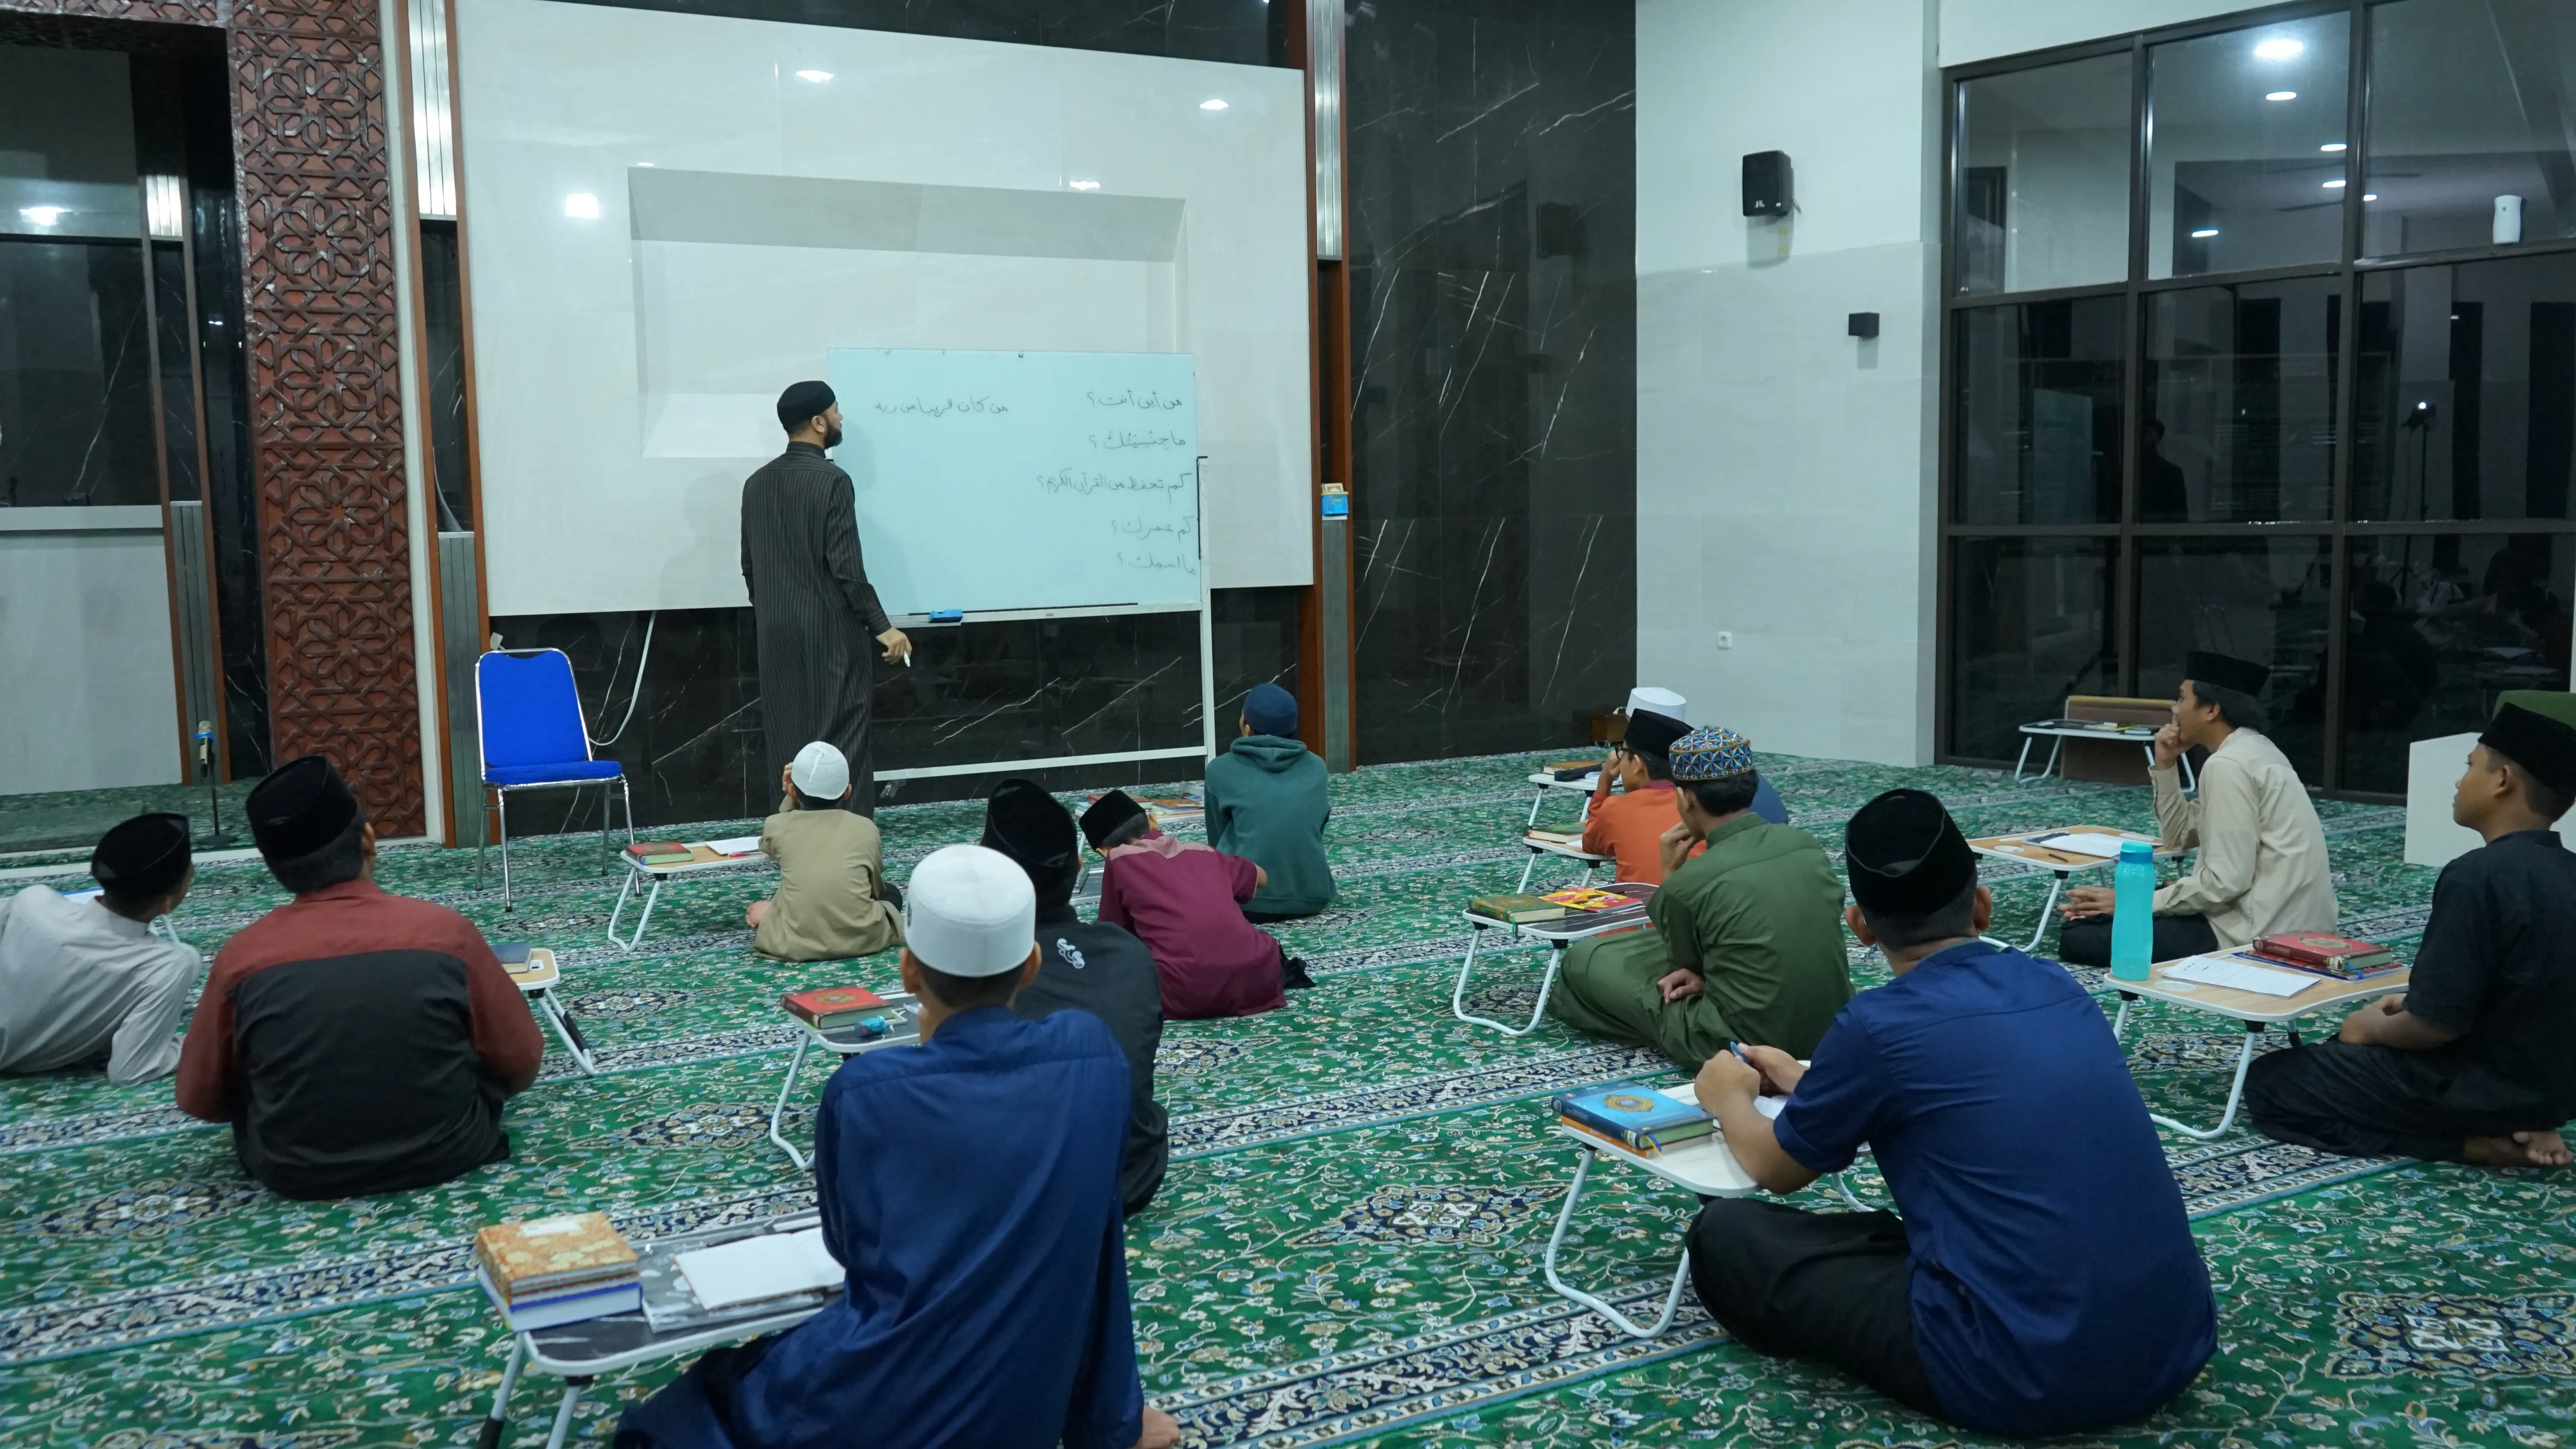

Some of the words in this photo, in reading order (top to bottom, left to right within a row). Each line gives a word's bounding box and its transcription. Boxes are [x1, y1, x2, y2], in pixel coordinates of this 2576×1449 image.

[900, 403, 917, 413] من
[917, 397, 953, 417] قريبا
[958, 395, 989, 412] كان
[990, 403, 1008, 413] من
[1138, 391, 1160, 409] أين
[1163, 397, 1182, 409] من
[1170, 430, 1186, 446] ما
[1109, 479, 1125, 490] من
[1168, 472, 1193, 504] كم
[1178, 515, 1195, 543] كم
[1182, 554, 1197, 575] ما
